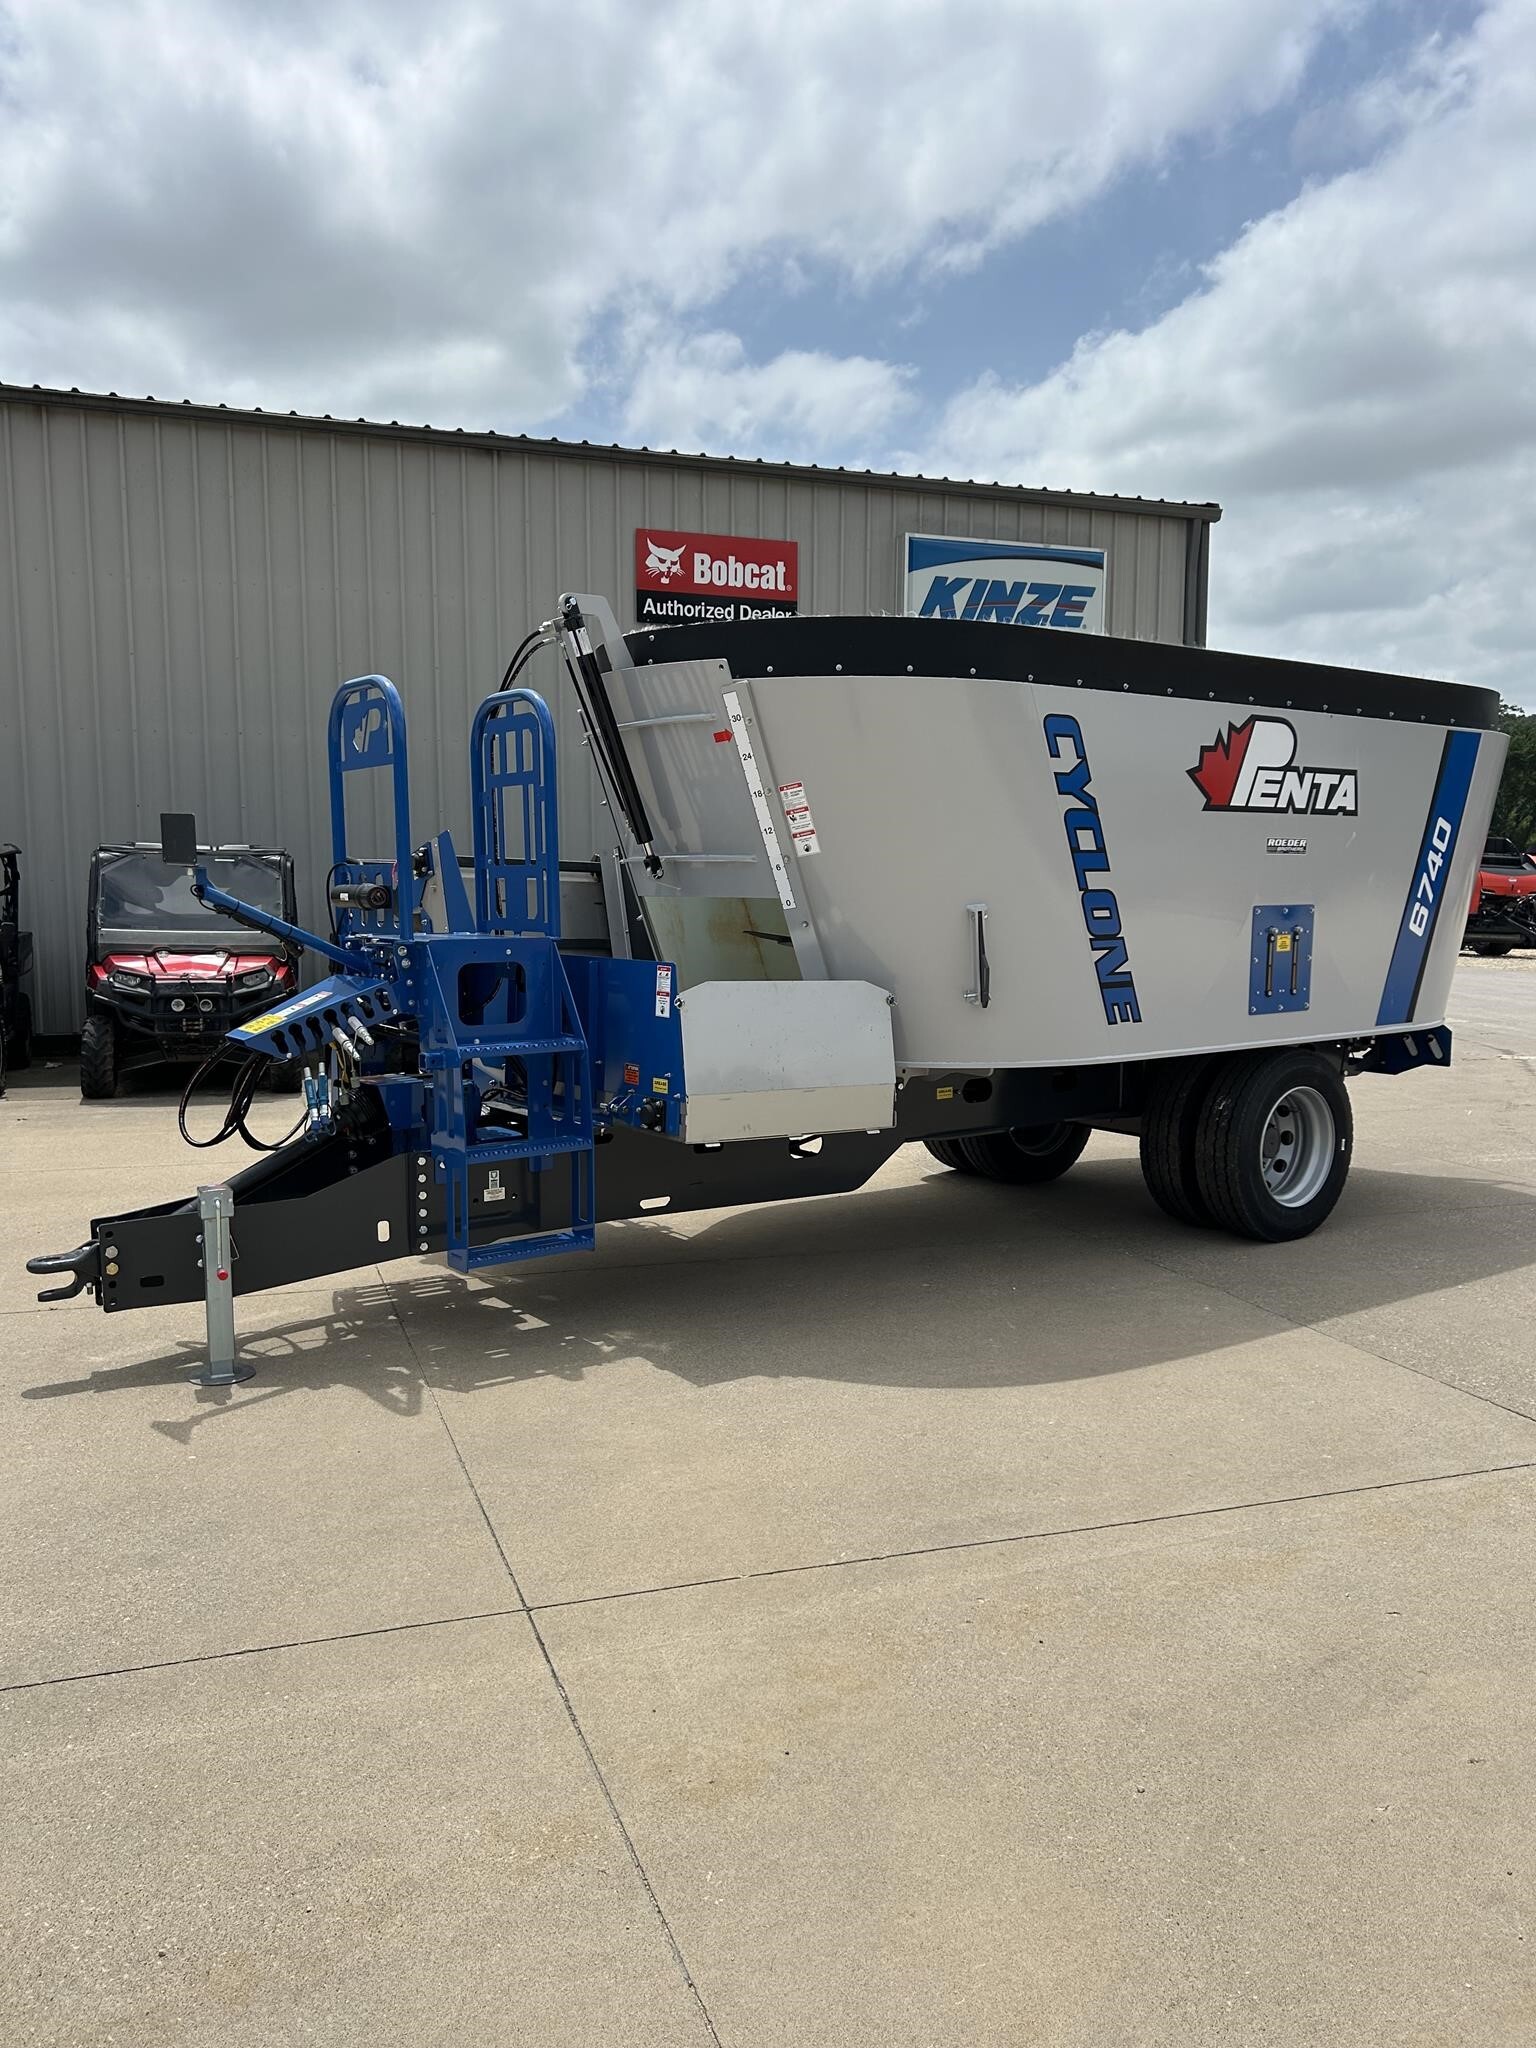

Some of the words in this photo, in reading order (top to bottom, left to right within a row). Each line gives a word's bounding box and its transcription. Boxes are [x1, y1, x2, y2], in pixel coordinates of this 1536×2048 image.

[693, 552, 786, 591] Bobcat
[918, 576, 1097, 628] KINZE
[643, 598, 735, 621] Authorized
[732, 713, 742, 723] 30
[742, 752, 752, 761] 24
[1228, 715, 1358, 815] PENTA
[753, 789, 763, 798] 18
[764, 826, 773, 835] 12
[1267, 838, 1307, 847] ROEDER
[775, 863, 782, 871] 6
[1043, 713, 1143, 1025] CYCLONE
[1408, 816, 1452, 937] 6740
[785, 899, 791, 907] 0
